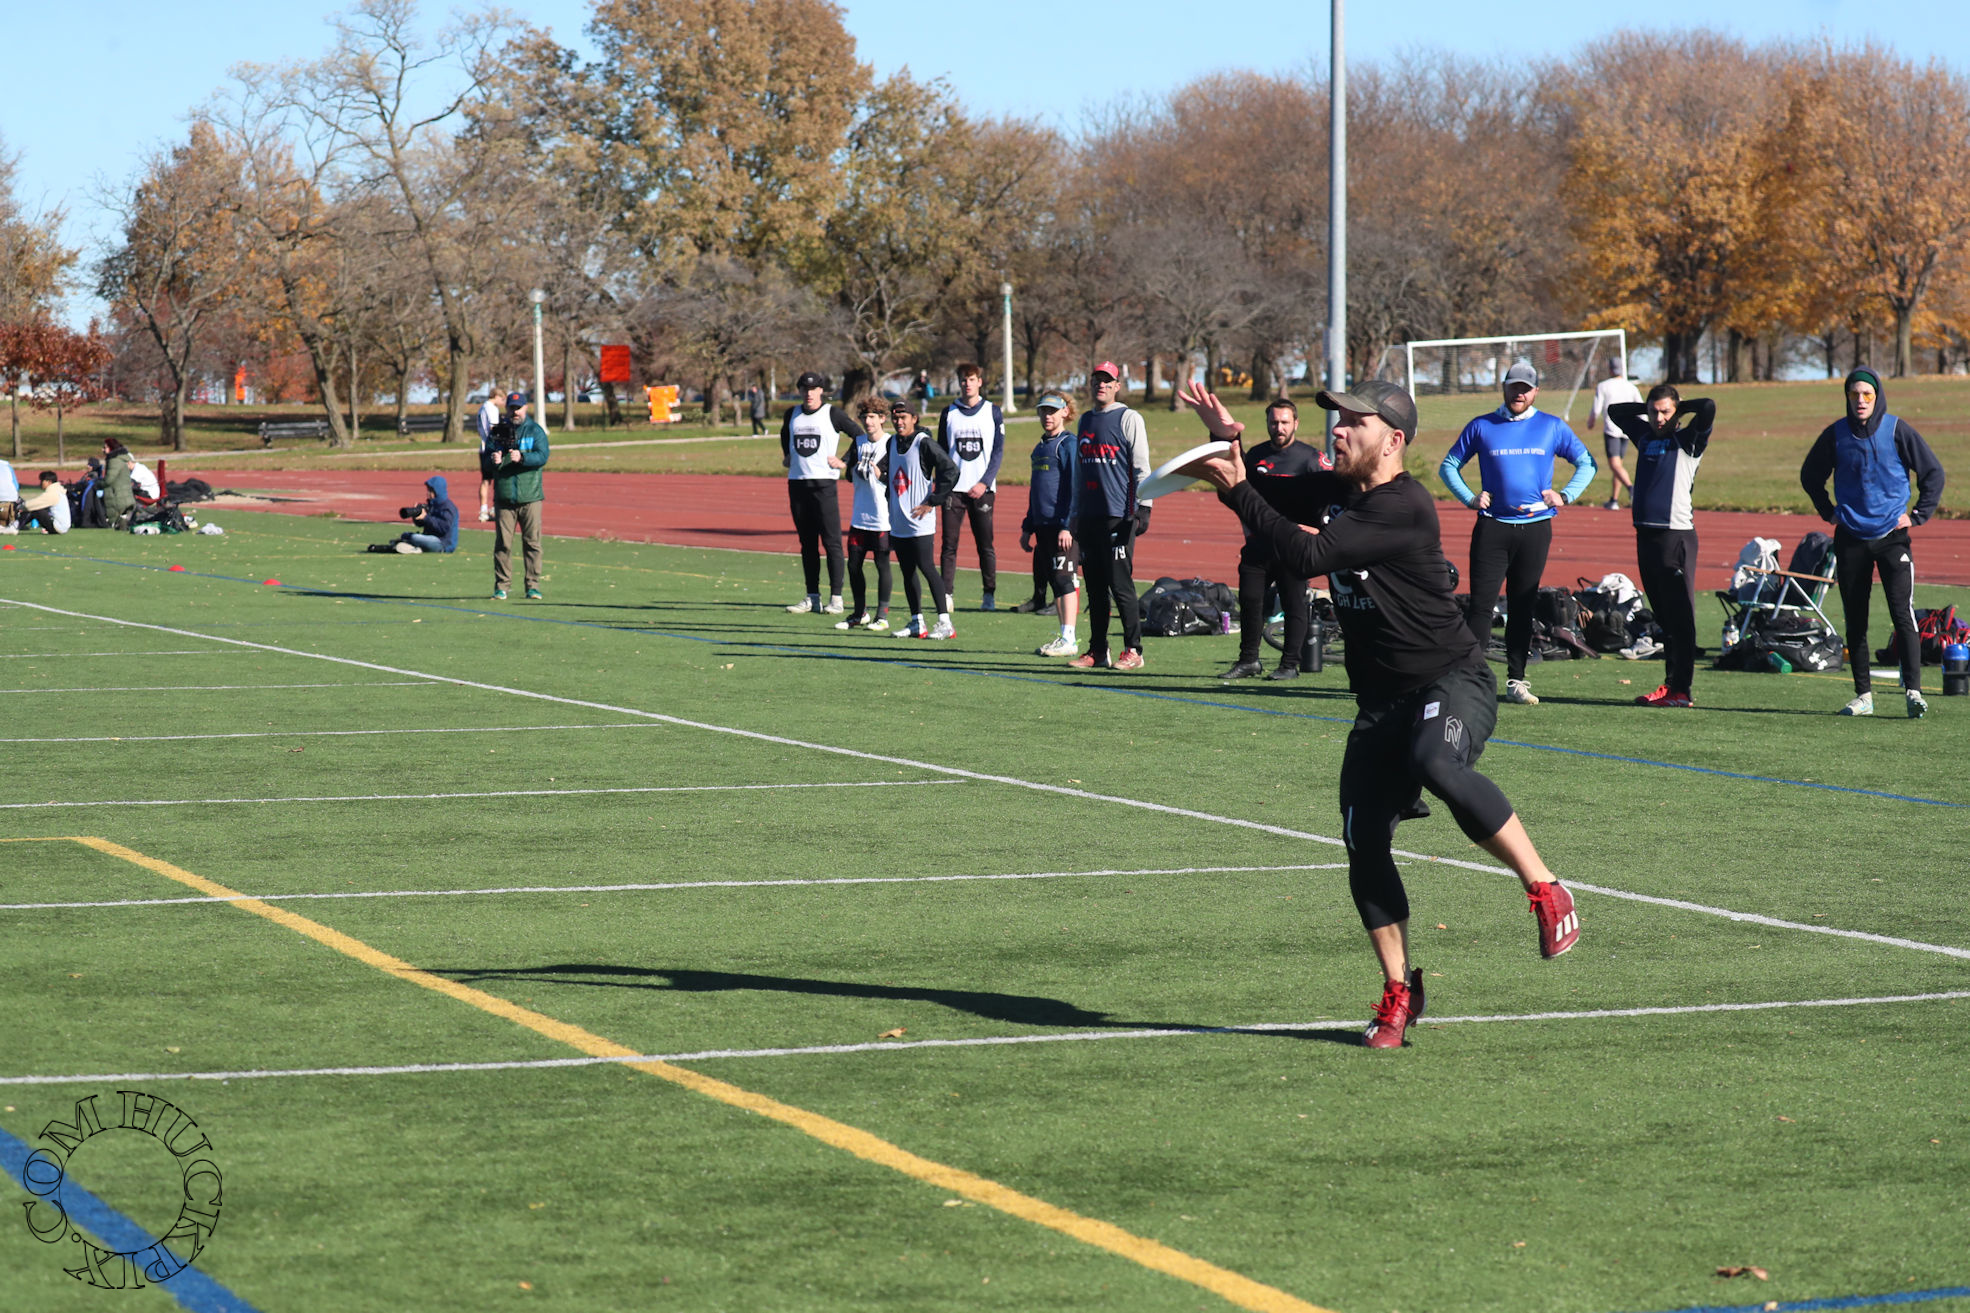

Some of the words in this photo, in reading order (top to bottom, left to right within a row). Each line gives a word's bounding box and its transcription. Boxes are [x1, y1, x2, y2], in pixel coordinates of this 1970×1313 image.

[796, 438, 817, 449] I-69
[958, 441, 980, 452] I-69
[1052, 555, 1066, 570] 17
